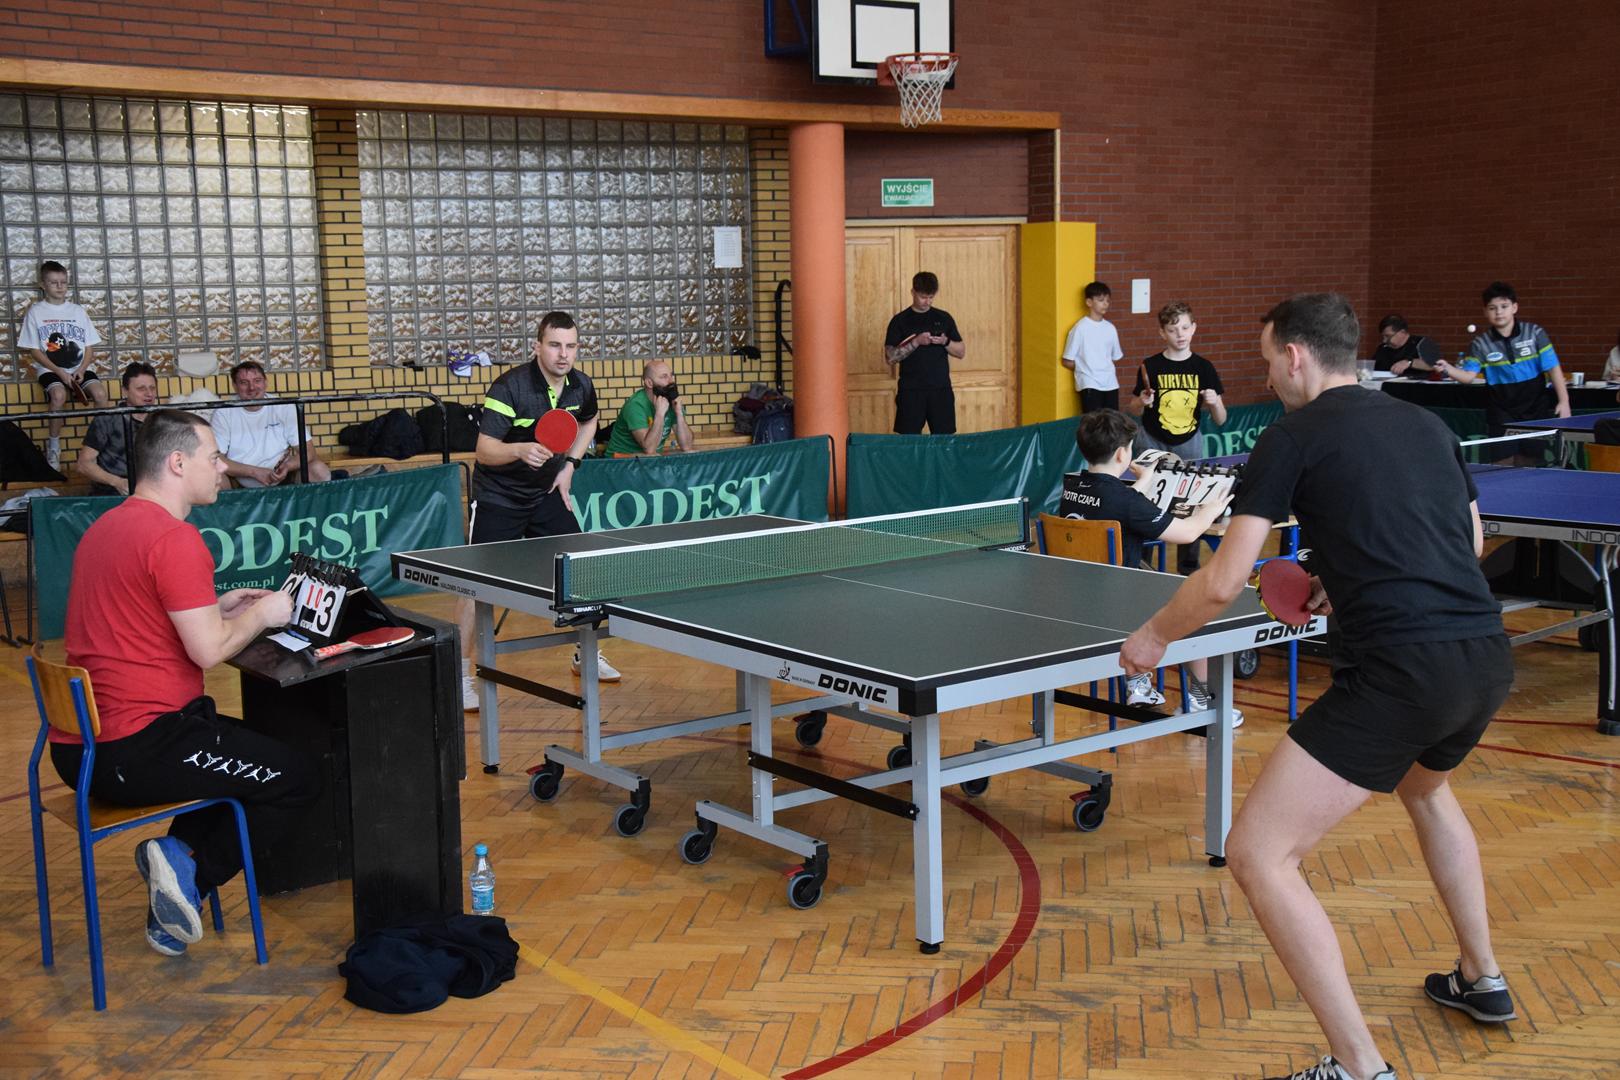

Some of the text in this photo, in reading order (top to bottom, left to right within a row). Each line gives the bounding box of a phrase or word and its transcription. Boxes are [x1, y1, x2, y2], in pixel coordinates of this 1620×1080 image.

[886, 182, 929, 193] WYJŚCIE
[1158, 374, 1199, 389] NIRVANA
[1202, 425, 1267, 459] DES
[569, 472, 771, 533] MODEST
[1078, 494, 1101, 507] CZAPLA
[1151, 479, 1167, 506] 3
[200, 505, 389, 573] ODEST
[1571, 529, 1620, 544] INDO
[214, 575, 275, 591] st.com.pl
[404, 568, 440, 587] DONIC
[317, 590, 336, 632] 3
[1254, 618, 1318, 643] DONIC
[818, 673, 888, 703] DONIC
